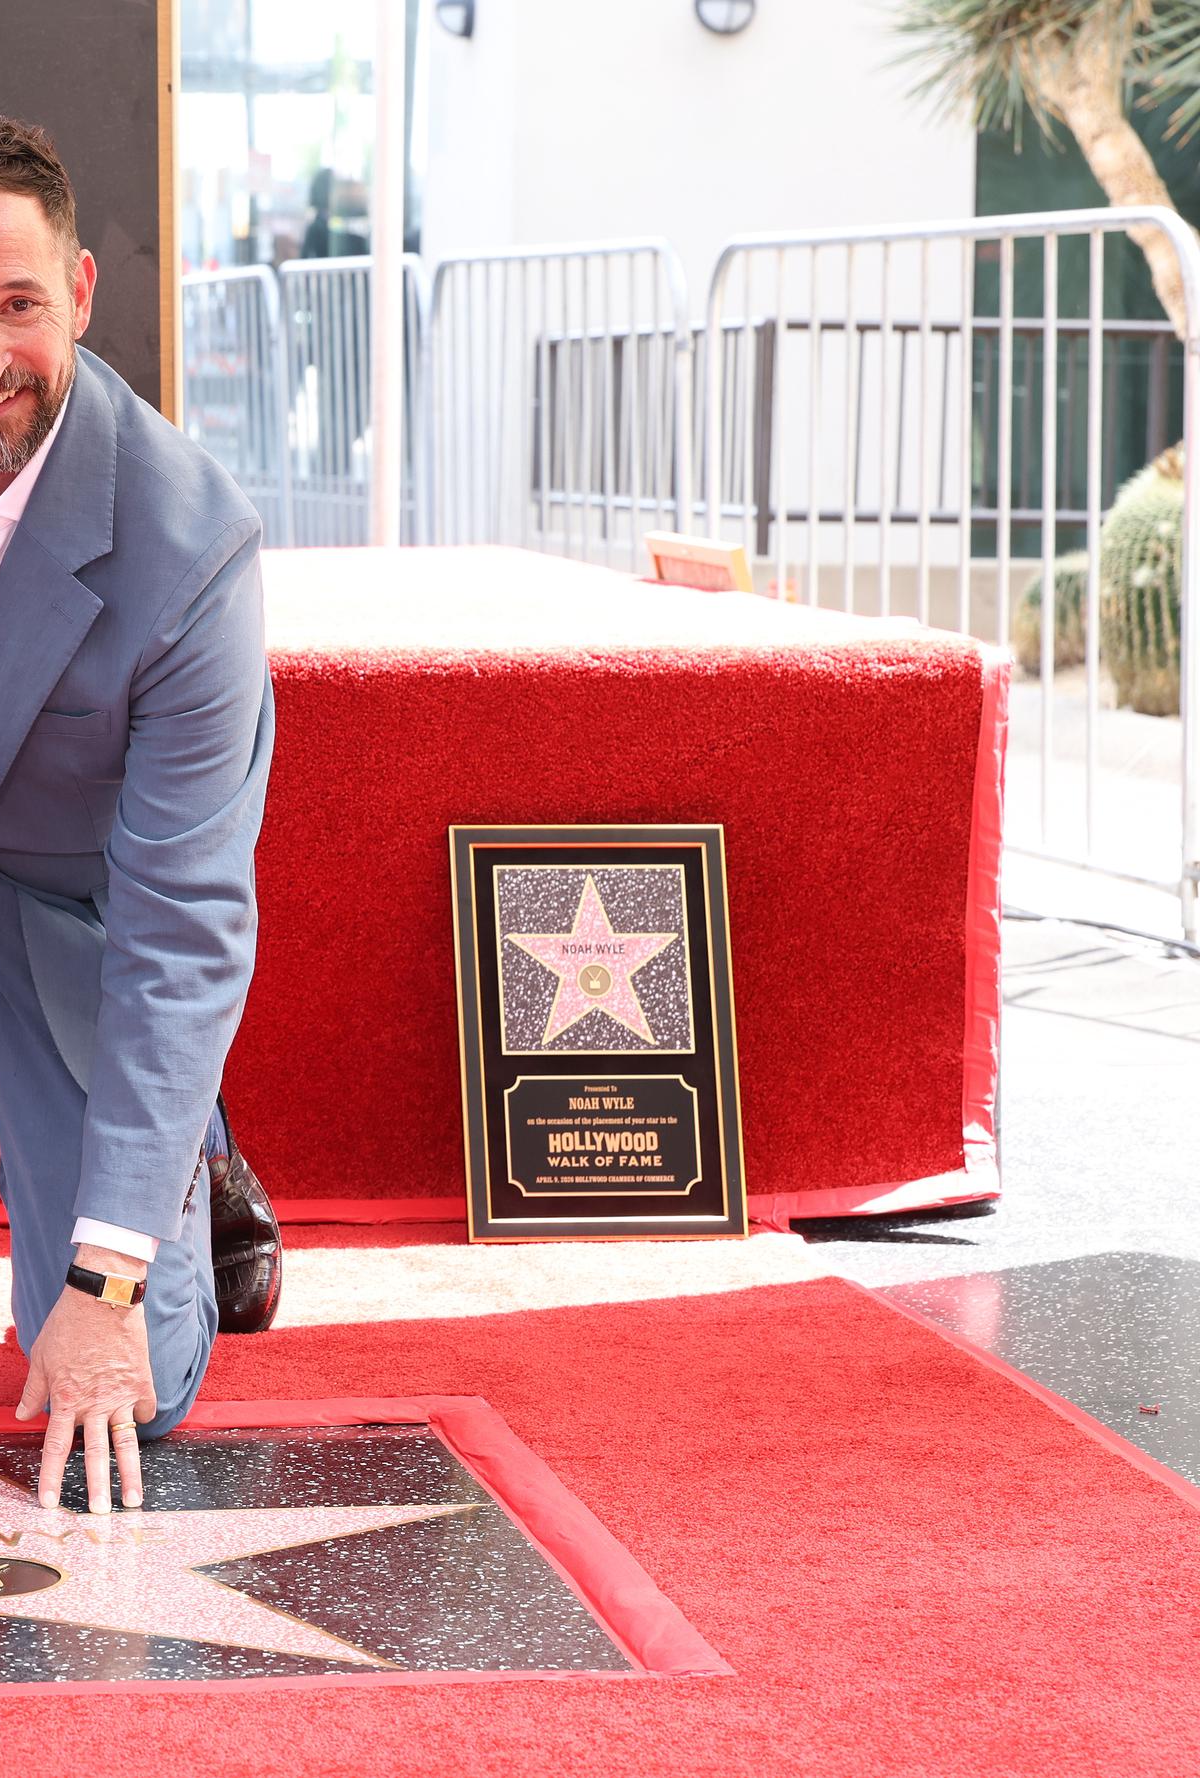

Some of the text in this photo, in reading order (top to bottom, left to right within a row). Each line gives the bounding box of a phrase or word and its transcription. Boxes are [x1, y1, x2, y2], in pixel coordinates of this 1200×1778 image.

[562, 944, 625, 955] NOAH WYLE
[568, 1097, 635, 1110] NOAH WYLE
[535, 1117, 546, 1126] the
[546, 1117, 574, 1126] occasion
[574, 1117, 581, 1125] of
[581, 1117, 592, 1125] the
[592, 1117, 624, 1126] placement
[624, 1116, 631, 1125] of
[631, 1117, 645, 1126] your
[646, 1117, 659, 1125] star
[659, 1117, 667, 1125] in
[667, 1116, 678, 1125] the
[548, 1131, 658, 1153] HOLLYWOOD
[547, 1155, 663, 1168] WALK OF FAME
[608, 1175, 636, 1183] CHAMBER
